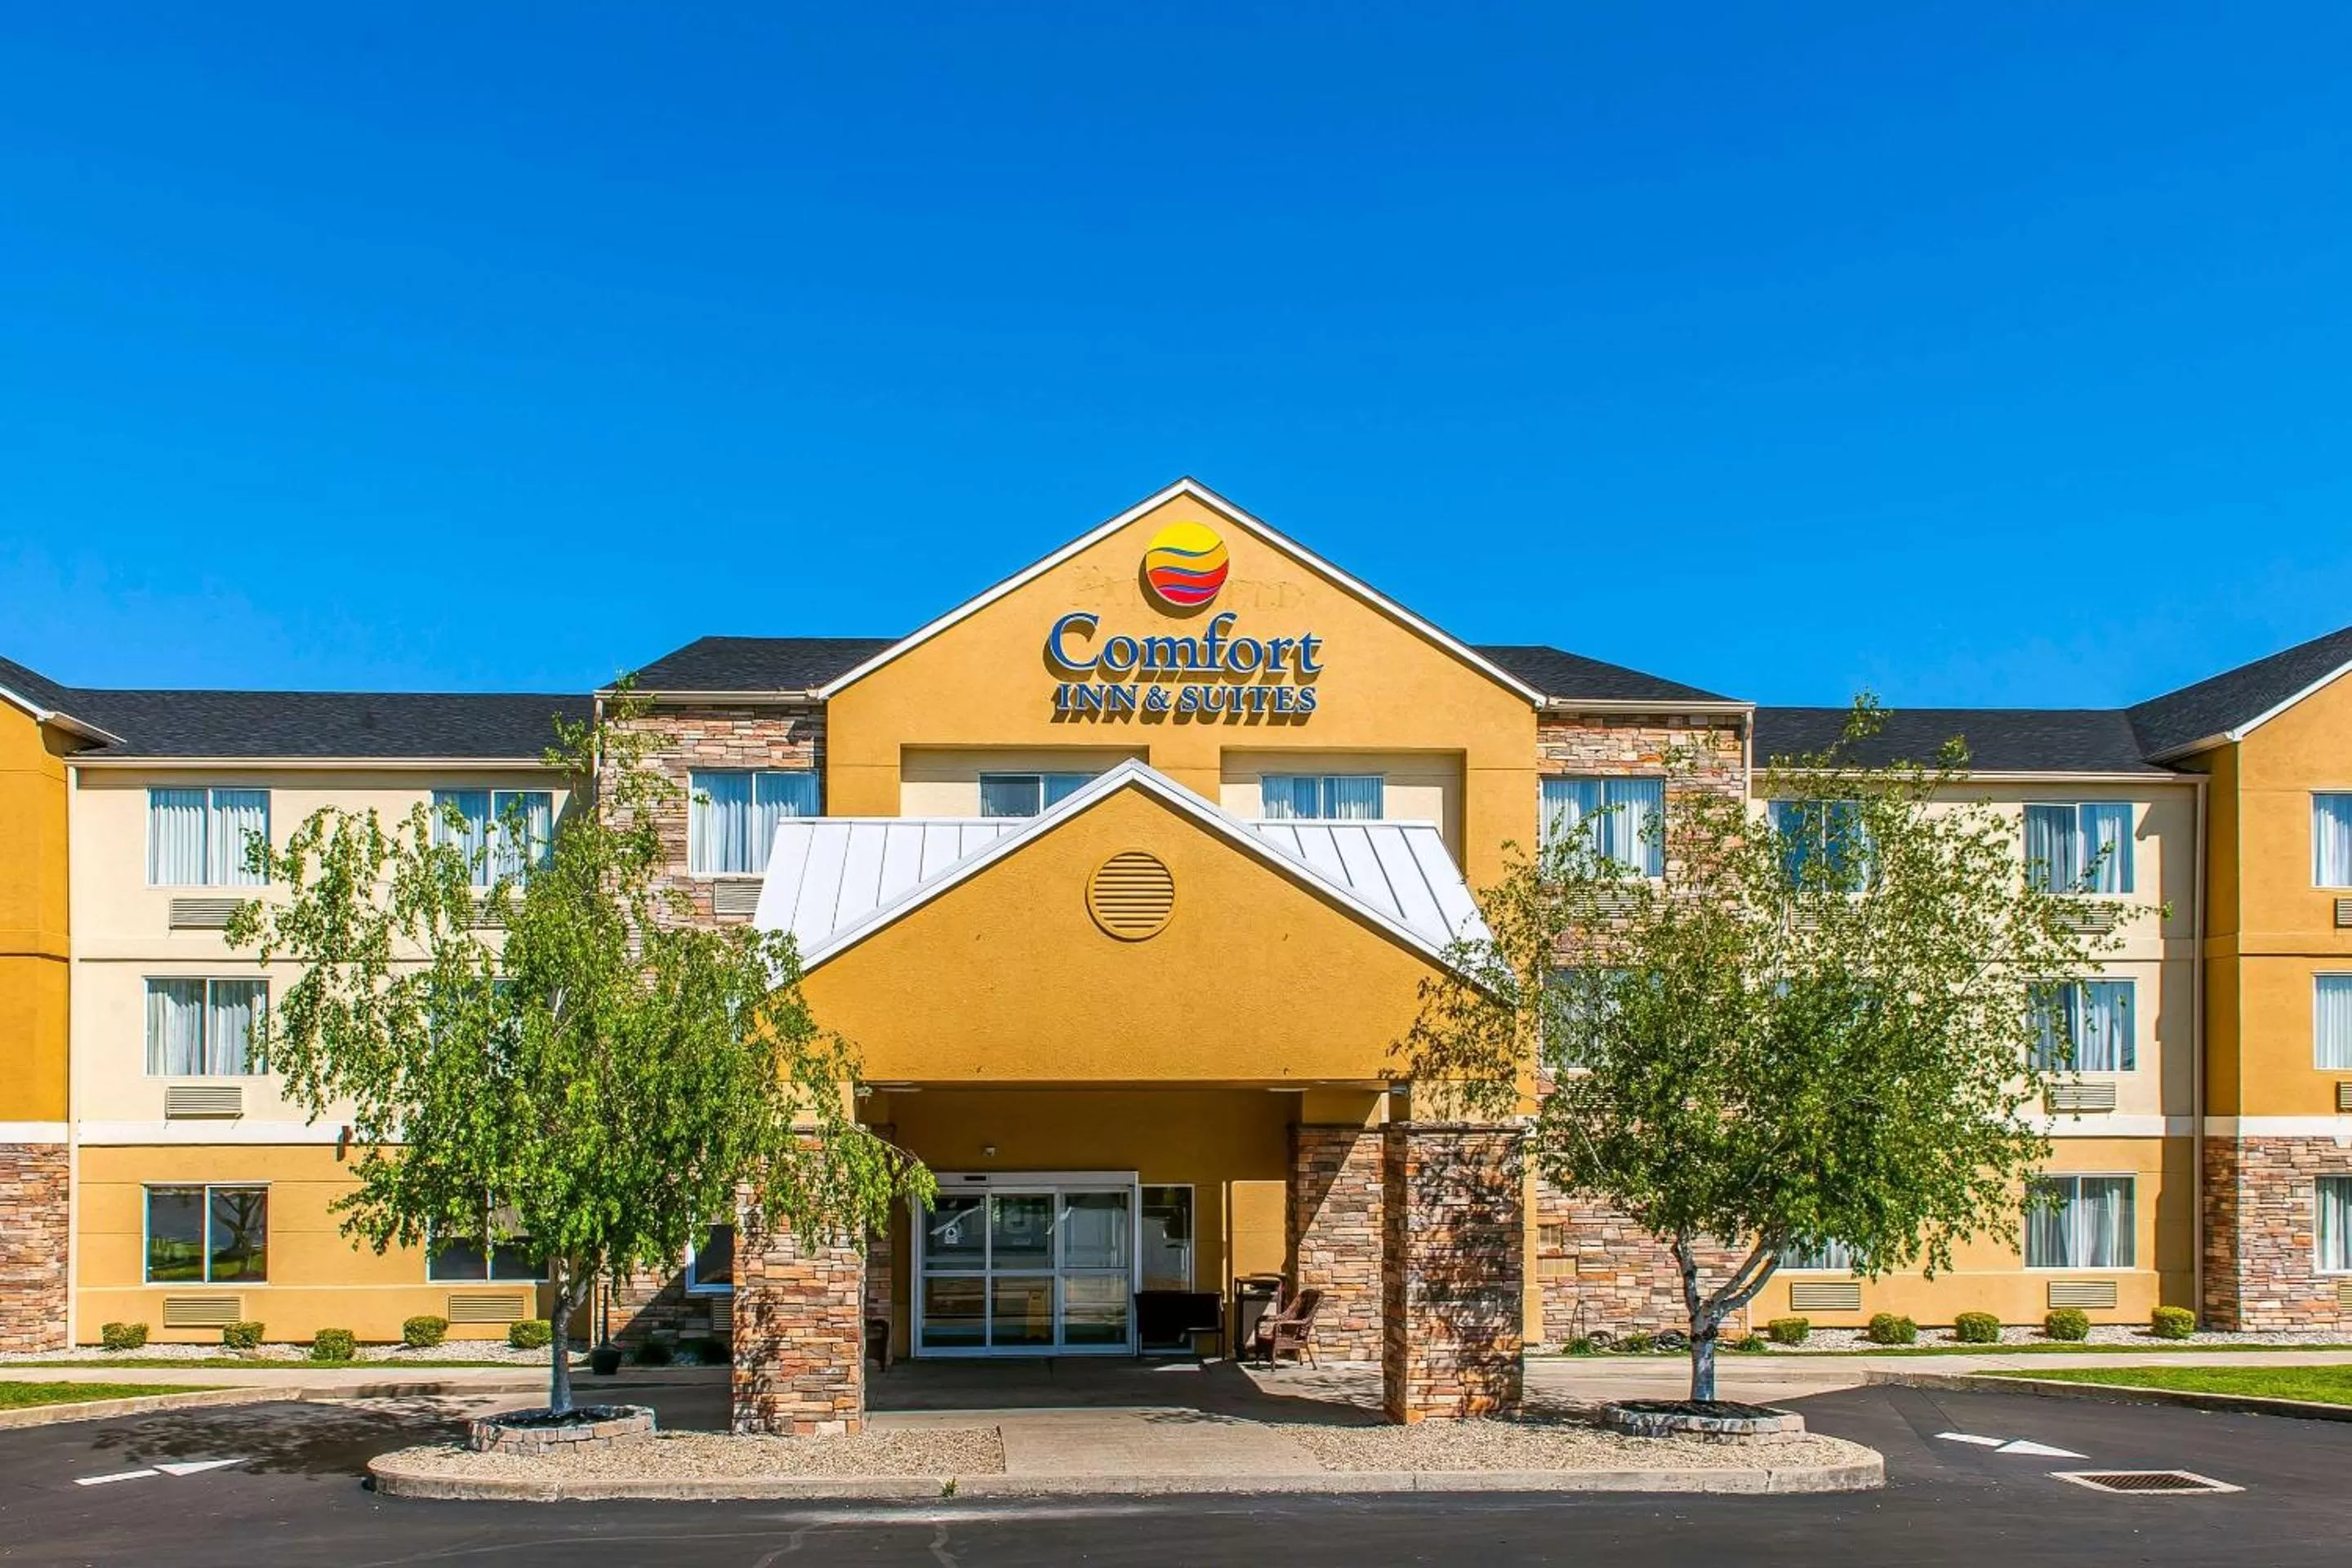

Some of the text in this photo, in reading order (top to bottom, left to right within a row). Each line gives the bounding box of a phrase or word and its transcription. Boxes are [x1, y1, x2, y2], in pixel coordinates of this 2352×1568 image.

[1049, 612, 1325, 673] Comfort
[1057, 683, 1318, 715] INN & SUITES
